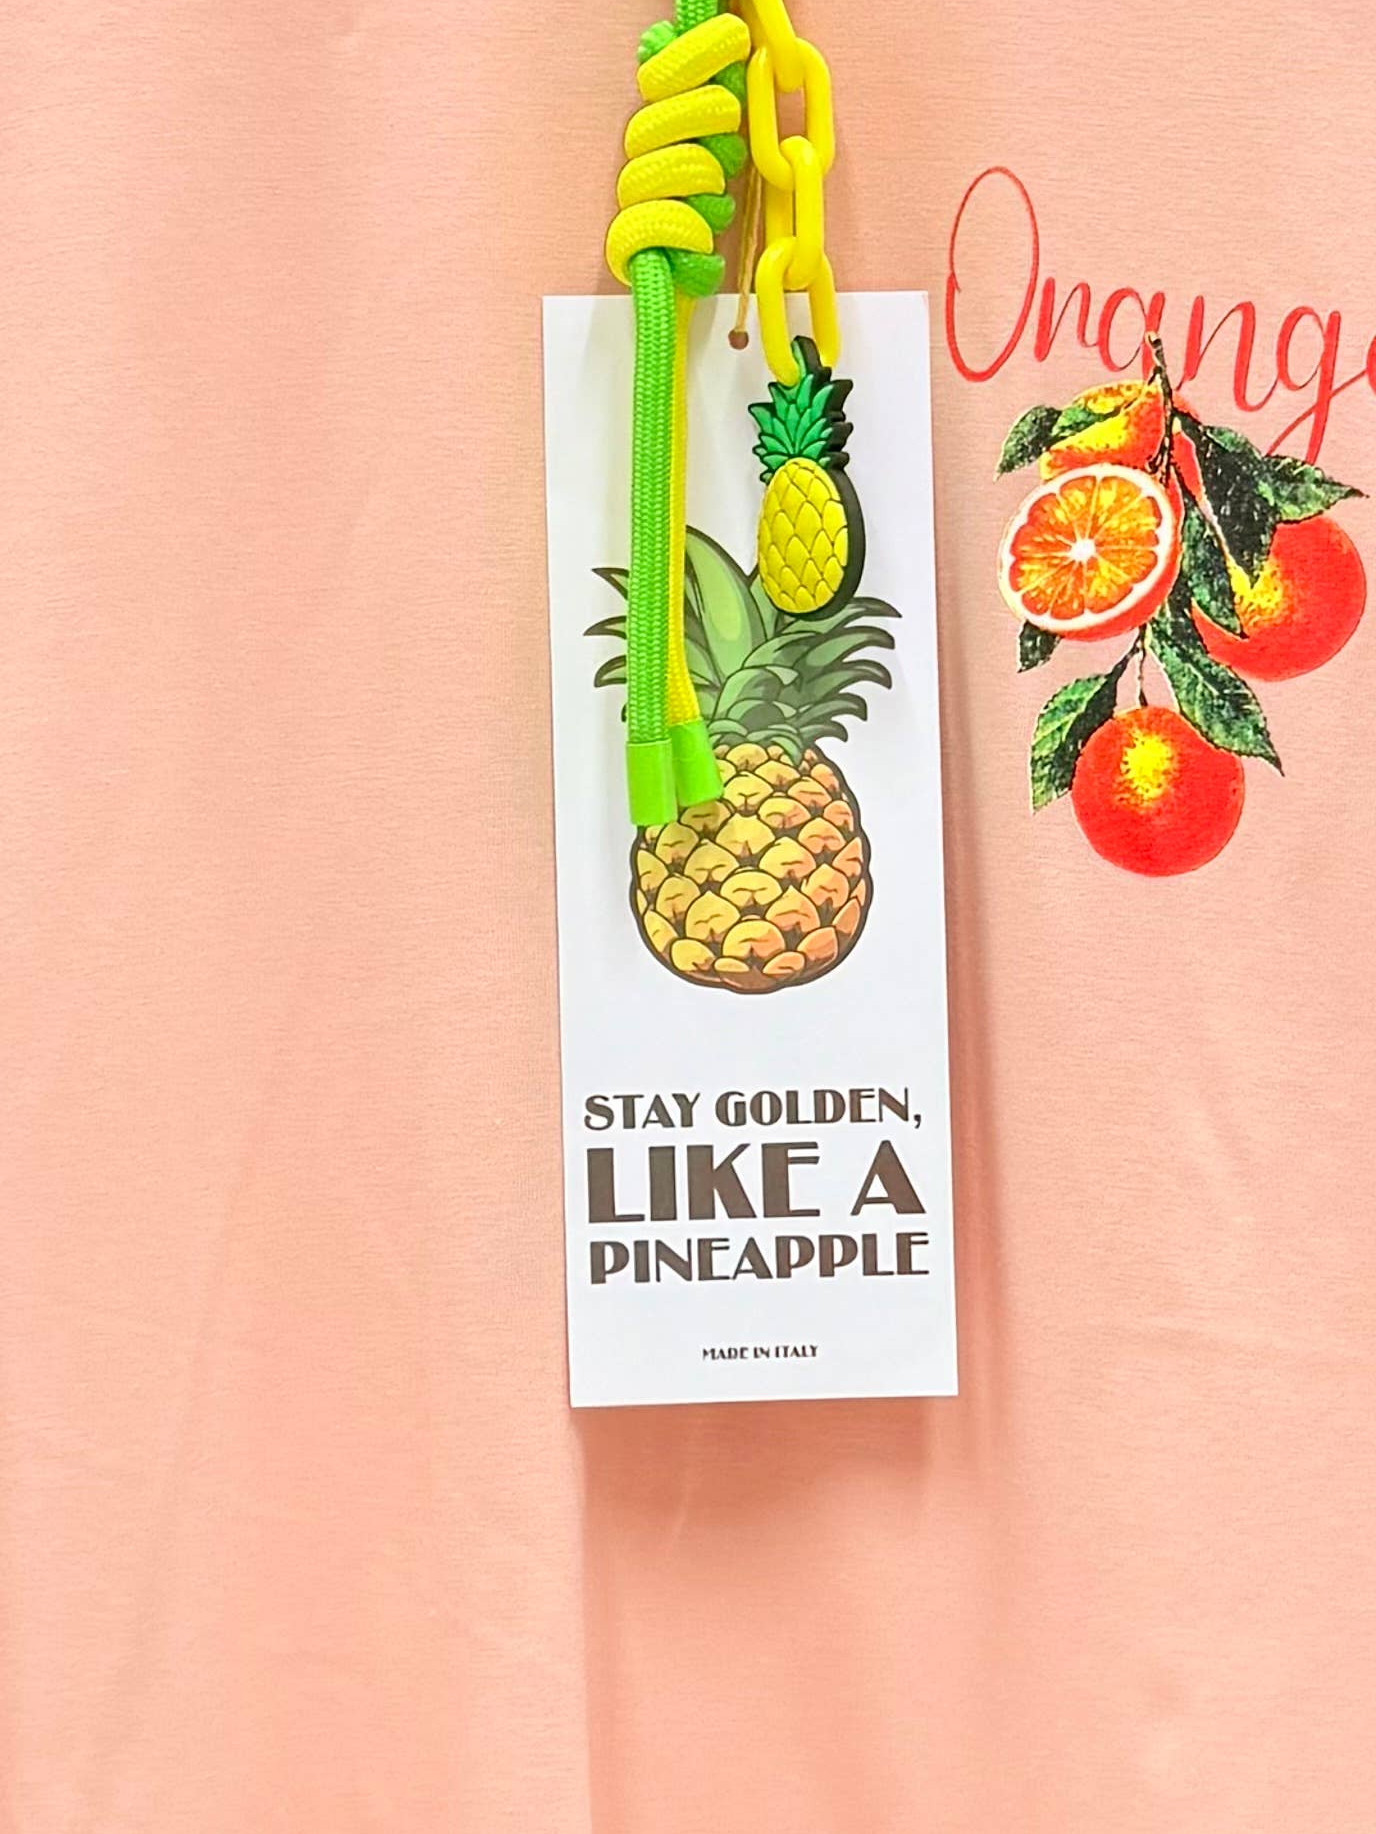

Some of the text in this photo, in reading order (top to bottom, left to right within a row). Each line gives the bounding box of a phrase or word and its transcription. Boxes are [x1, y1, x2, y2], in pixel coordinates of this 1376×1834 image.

[583, 1087, 922, 1131] STAY GOLDEN,
[586, 1139, 927, 1224] LIKE A
[589, 1231, 930, 1285] PINEAPPLE
[702, 1344, 818, 1361] MADE IN ITALY
